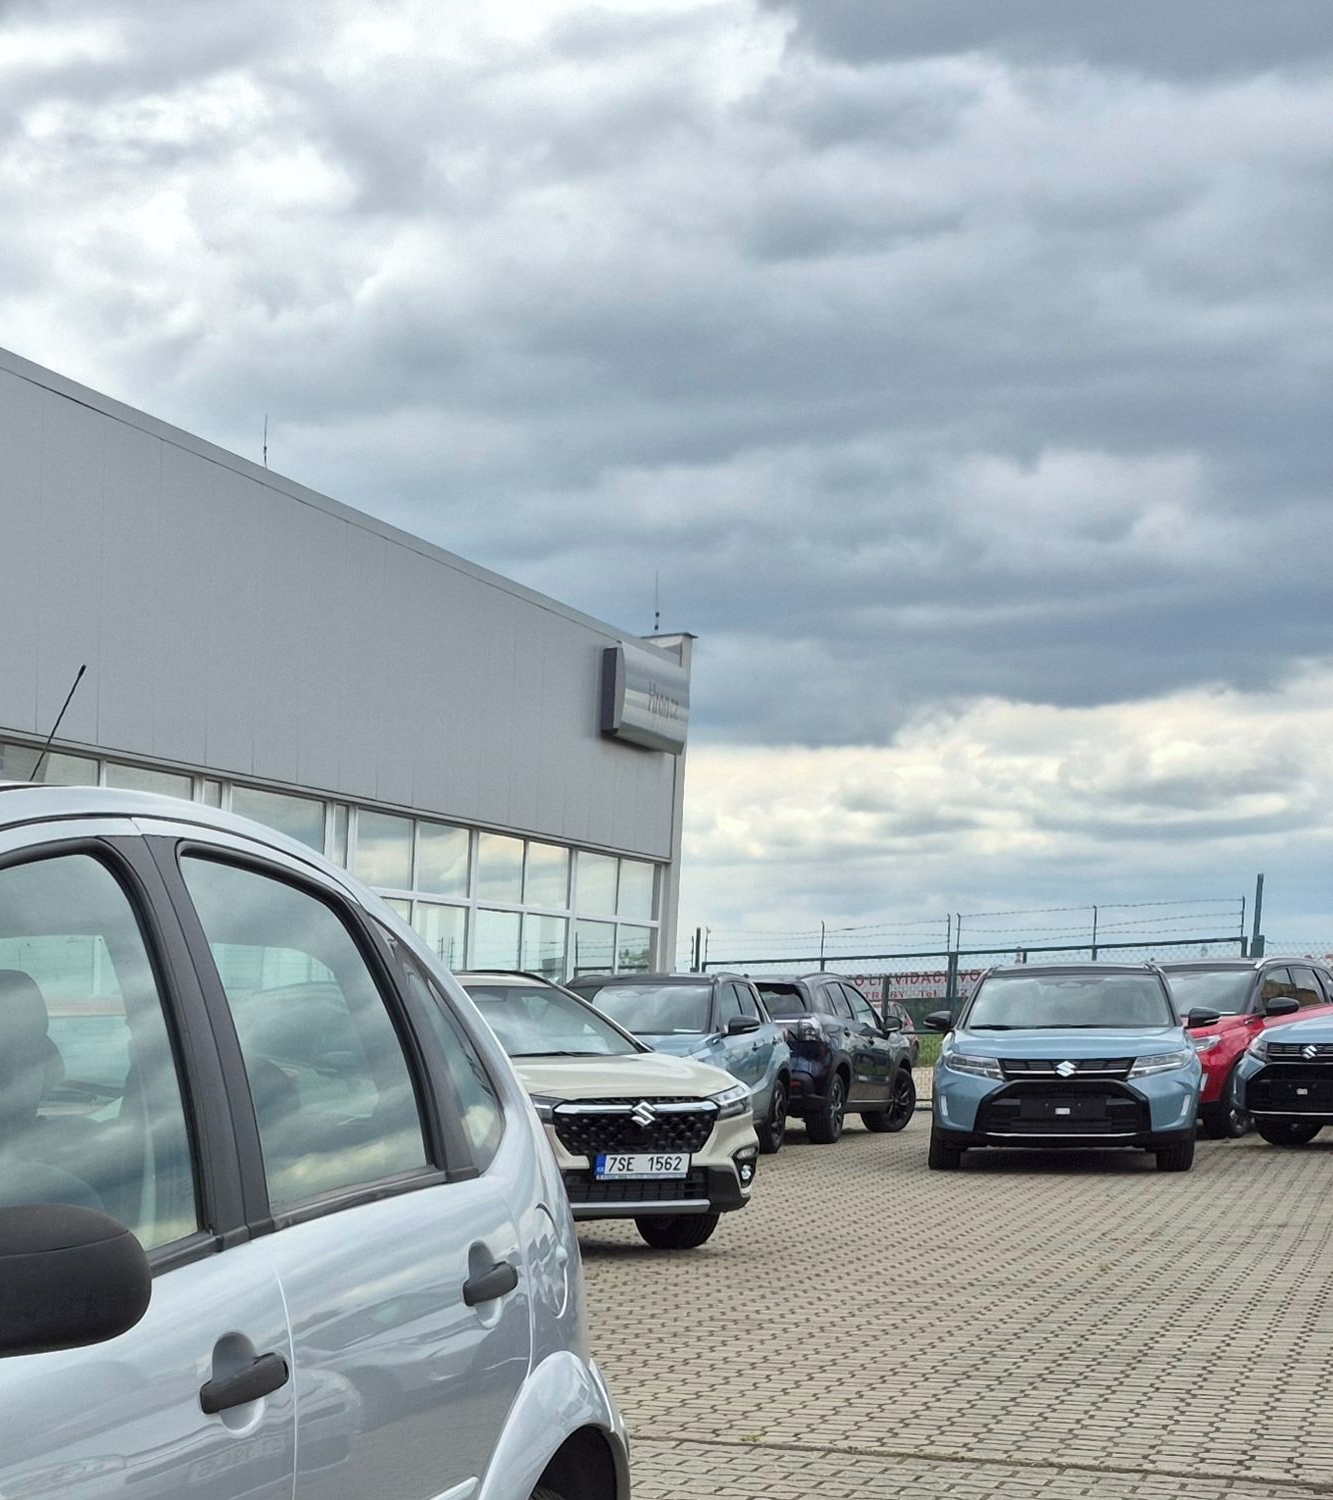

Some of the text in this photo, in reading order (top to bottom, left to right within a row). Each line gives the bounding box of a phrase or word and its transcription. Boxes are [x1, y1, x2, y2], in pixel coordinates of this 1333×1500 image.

[868, 970, 949, 986] LIVIDACI
[608, 1156, 635, 1172] 7SE
[647, 1155, 683, 1172] 1562
